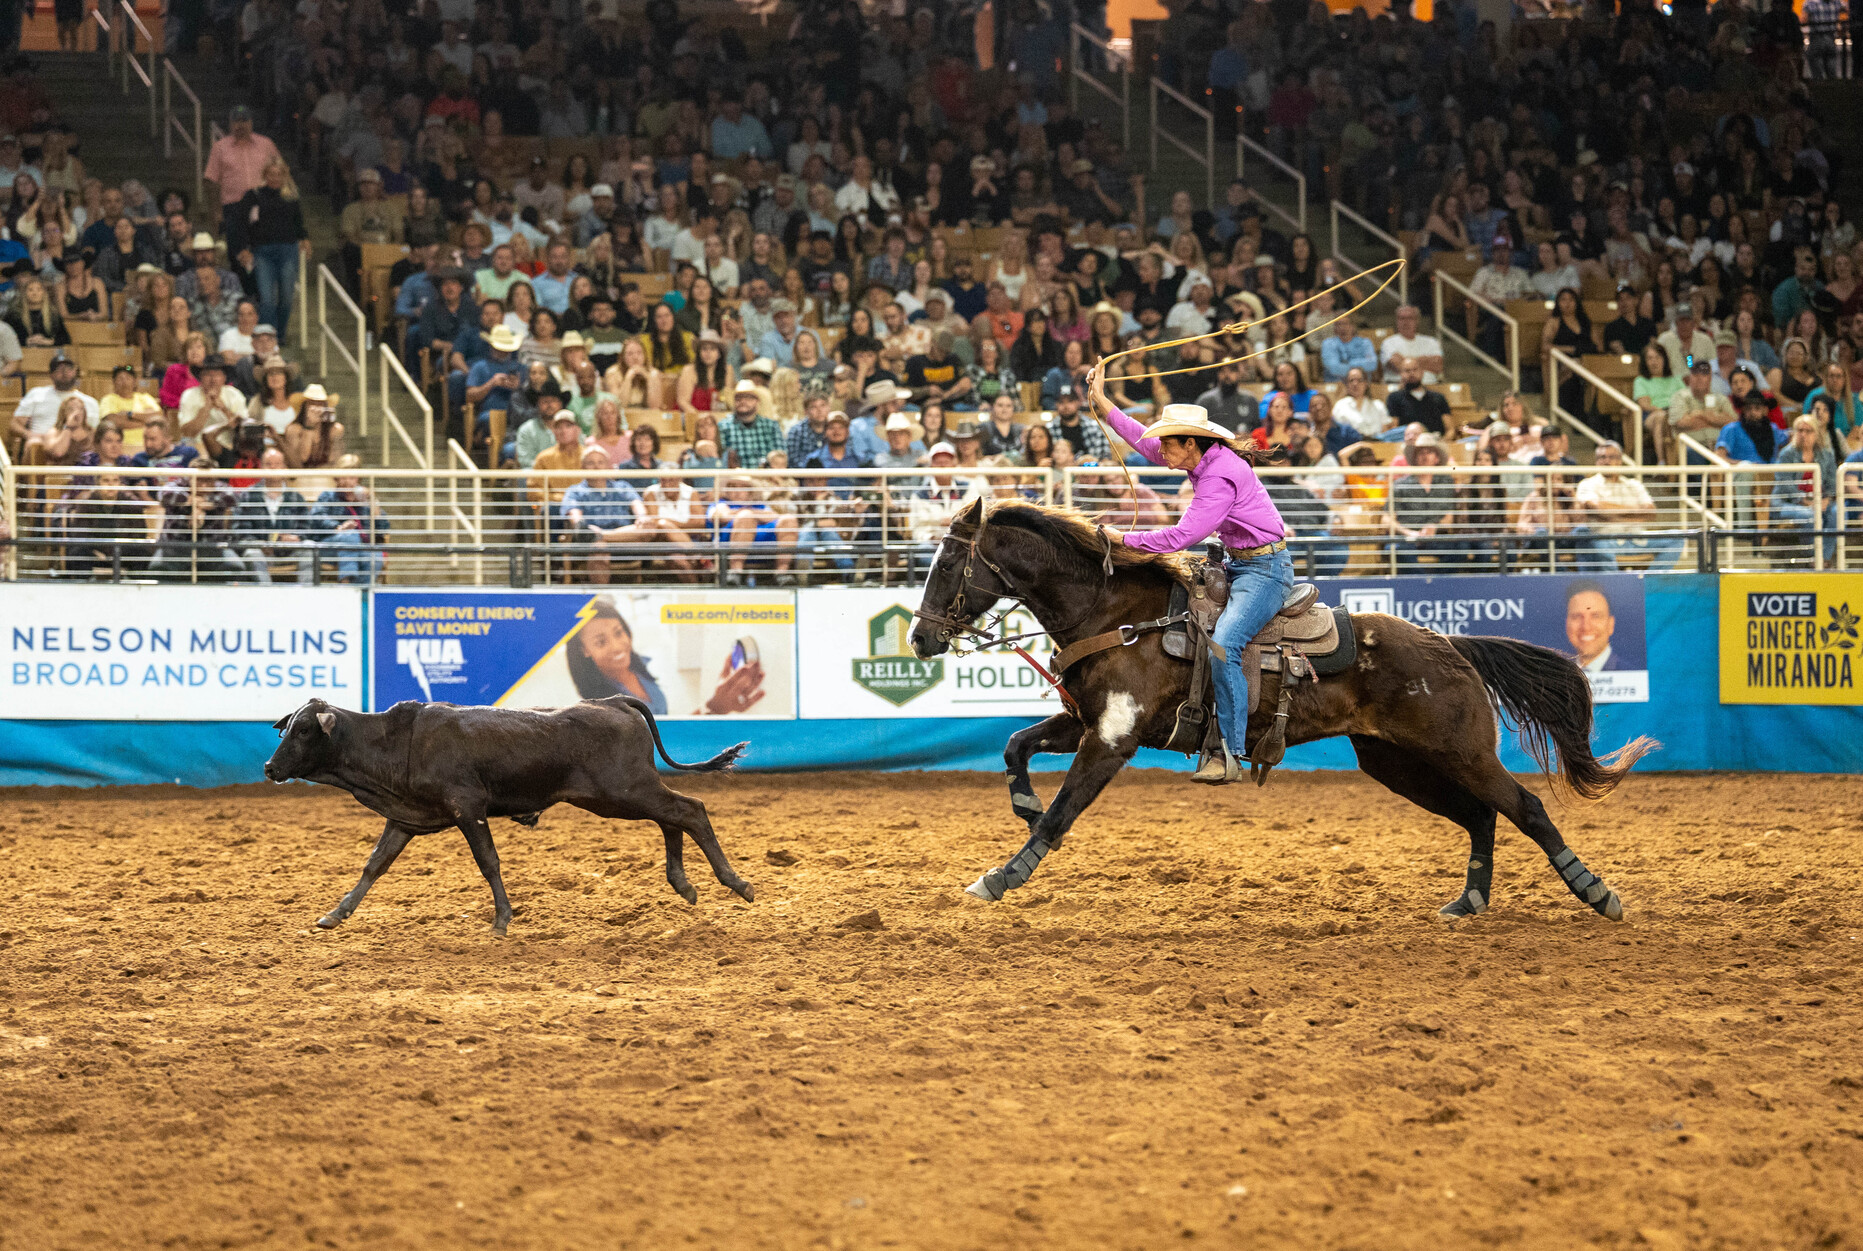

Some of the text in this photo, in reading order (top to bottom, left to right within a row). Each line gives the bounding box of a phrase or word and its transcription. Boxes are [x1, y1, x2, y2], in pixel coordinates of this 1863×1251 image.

[395, 606, 536, 621] CONSERVE ENERGY,
[666, 606, 790, 622] kua.com/rebates
[1752, 595, 1811, 615] VOTE
[395, 622, 491, 636] SAVE MONEY
[1747, 620, 1816, 649] GINGER
[12, 627, 348, 654] NELSON MULLINS
[396, 639, 464, 665] KUA
[12, 662, 347, 688] BROAD AND CASSEL
[859, 662, 936, 679] REILLY
[956, 666, 1051, 688] HOLDI
[1594, 676, 1613, 685] and
[1747, 653, 1853, 688] MIRANDA
